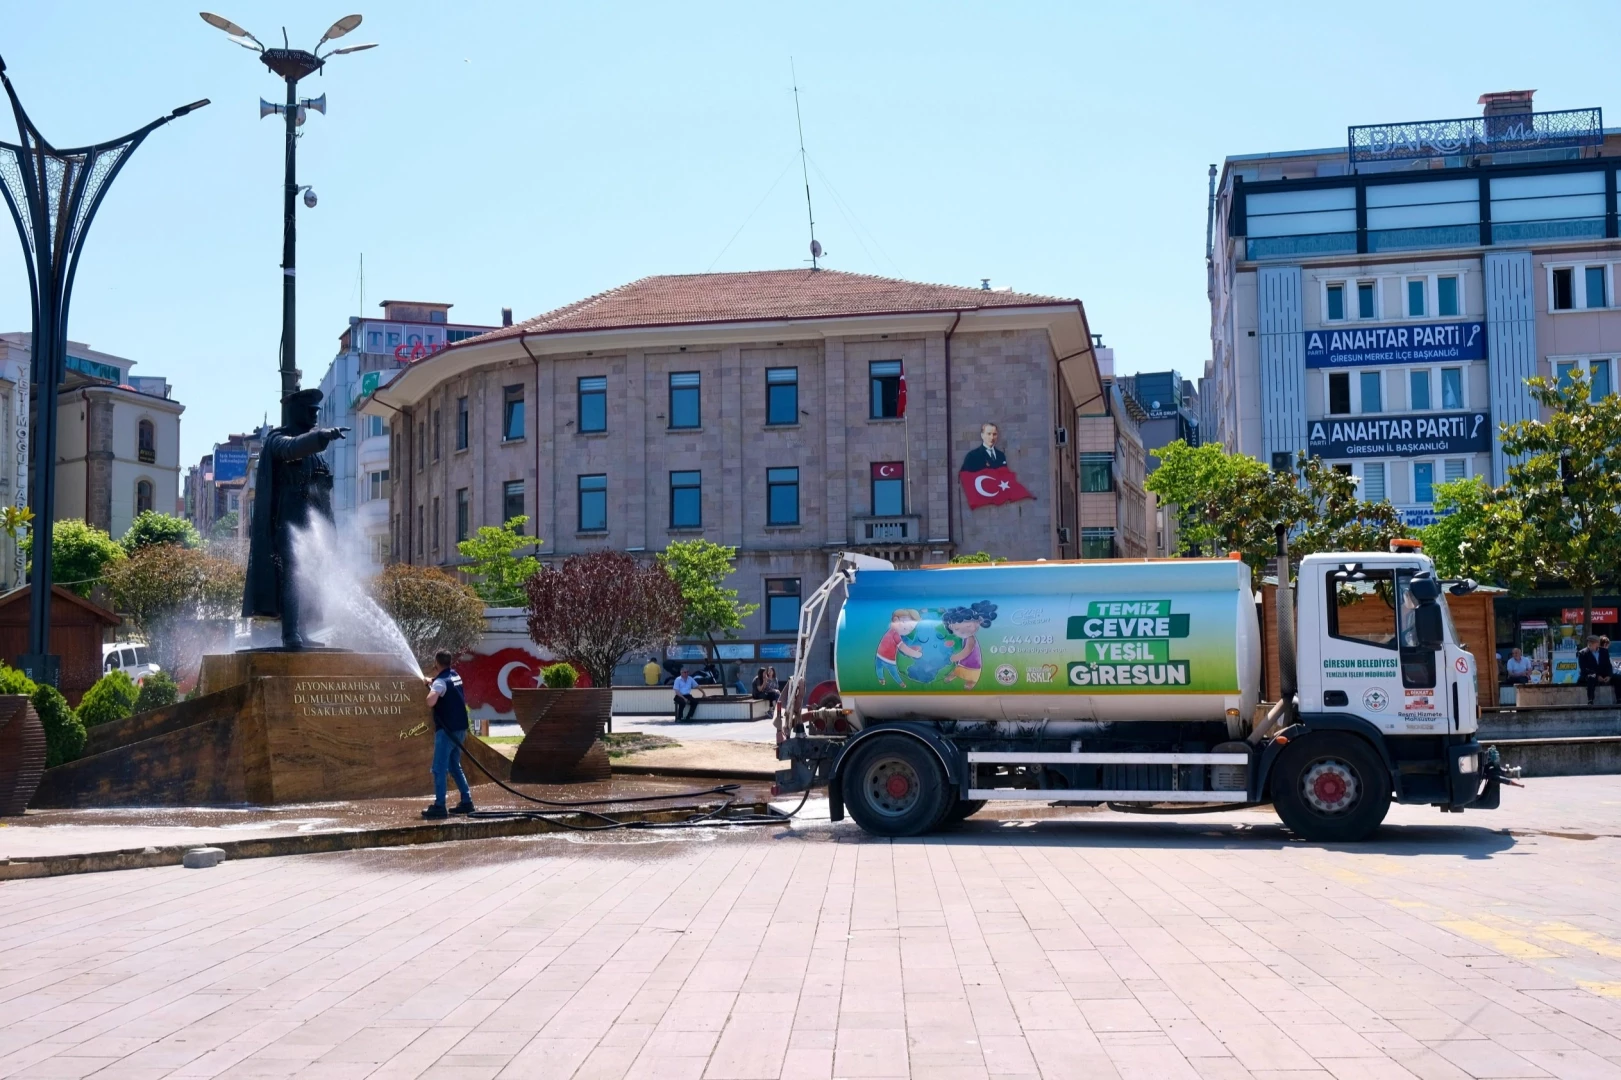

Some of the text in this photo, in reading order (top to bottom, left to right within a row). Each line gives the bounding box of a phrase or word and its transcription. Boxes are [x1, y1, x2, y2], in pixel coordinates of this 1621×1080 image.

[1308, 333, 1324, 350] A
[1330, 328, 1408, 351] ANAHTAR
[1330, 347, 1459, 363] GİRESUN MERKEZ İLÇE BAŞKANLIĞI
[1310, 422, 1327, 440] A
[1331, 419, 1412, 442] ANAHTAR
[1346, 440, 1449, 454] GİRESUN İL BAŞKANLIĞI
[1083, 617, 1170, 639] ÇEVRE
[1002, 635, 1054, 645] 444 4 028
[1323, 656, 1398, 668] GİRESUN BELEDİYESİ
[295, 680, 406, 692] AFYONKARAHİSAR VE
[294, 693, 365, 704] DUMLUPINAR
[368, 693, 382, 703] DA
[354, 706, 369, 716] DA
[370, 705, 402, 715] VARDI
